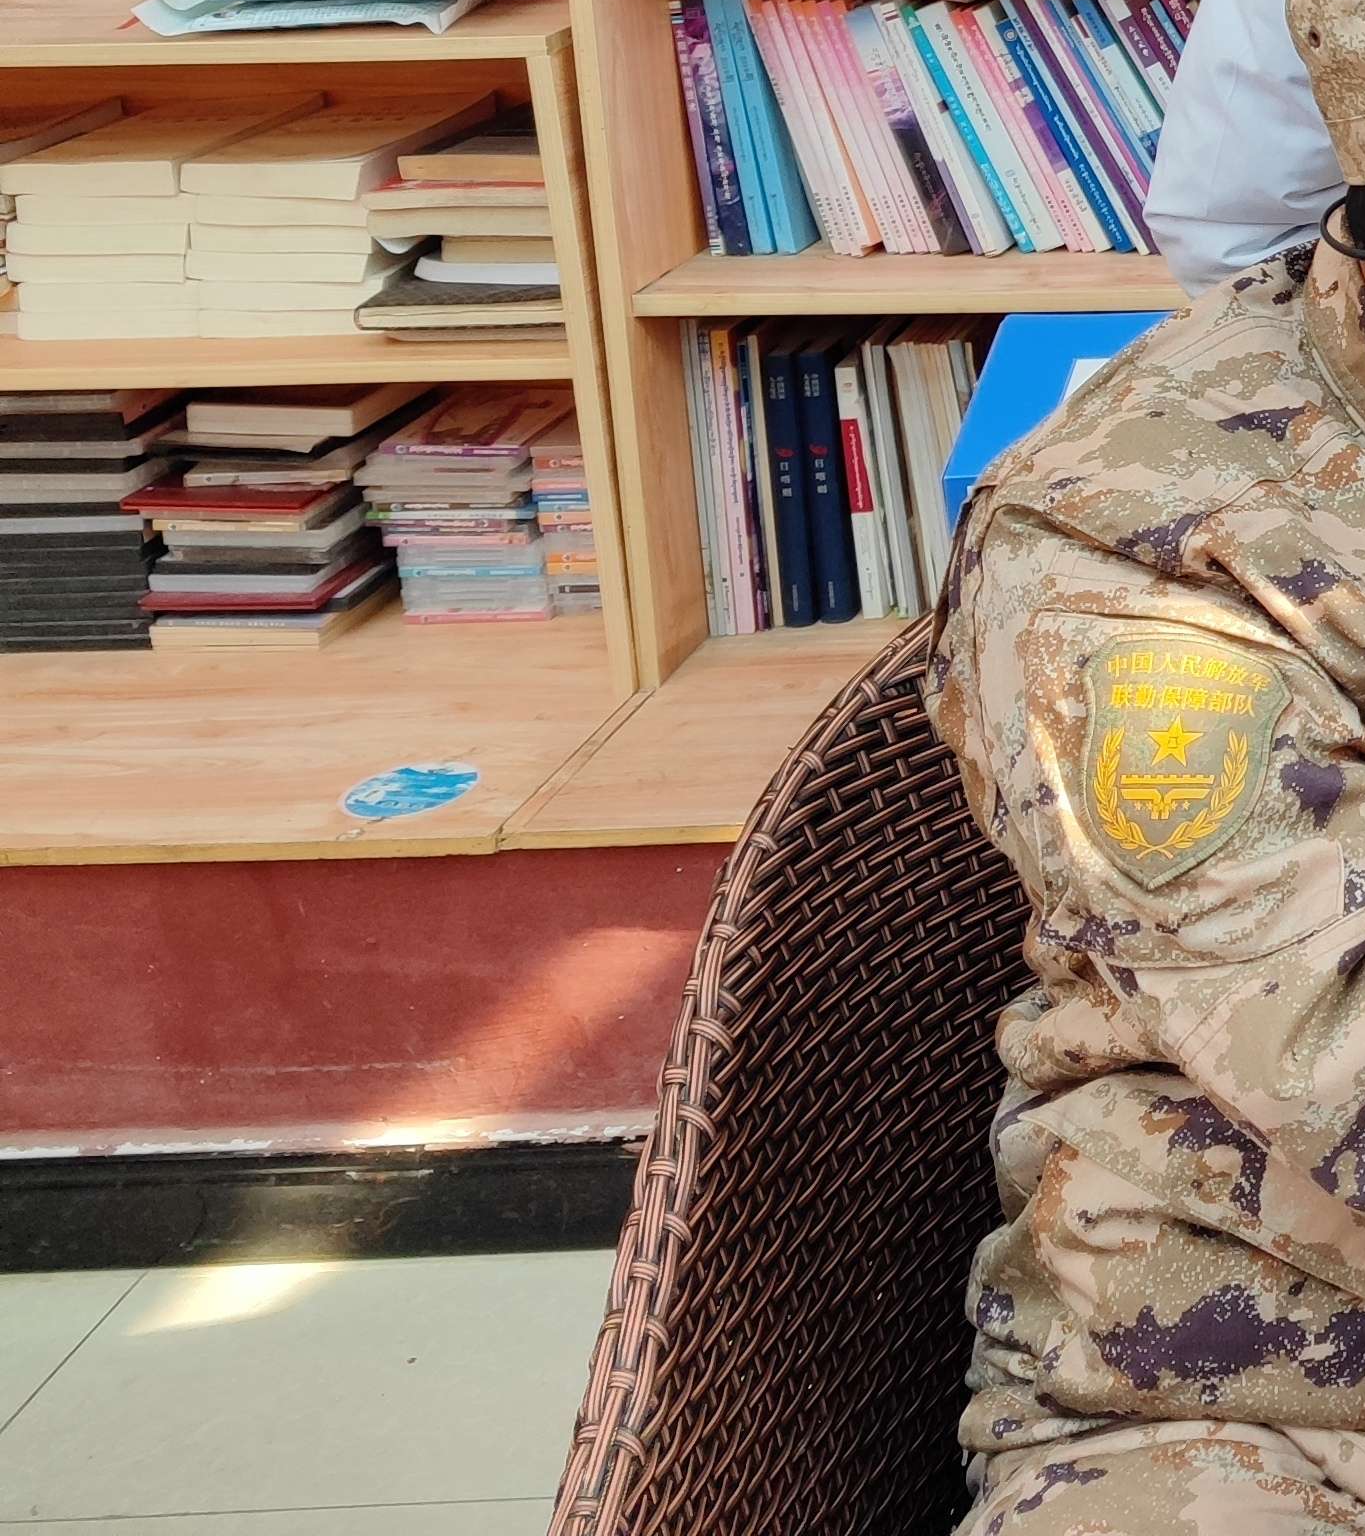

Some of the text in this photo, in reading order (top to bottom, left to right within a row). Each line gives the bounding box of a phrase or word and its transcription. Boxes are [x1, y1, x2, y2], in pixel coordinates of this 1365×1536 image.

[1107, 651, 1271, 693] 中国人民解放军
[1110, 684, 1256, 718] 联勤保障部队
